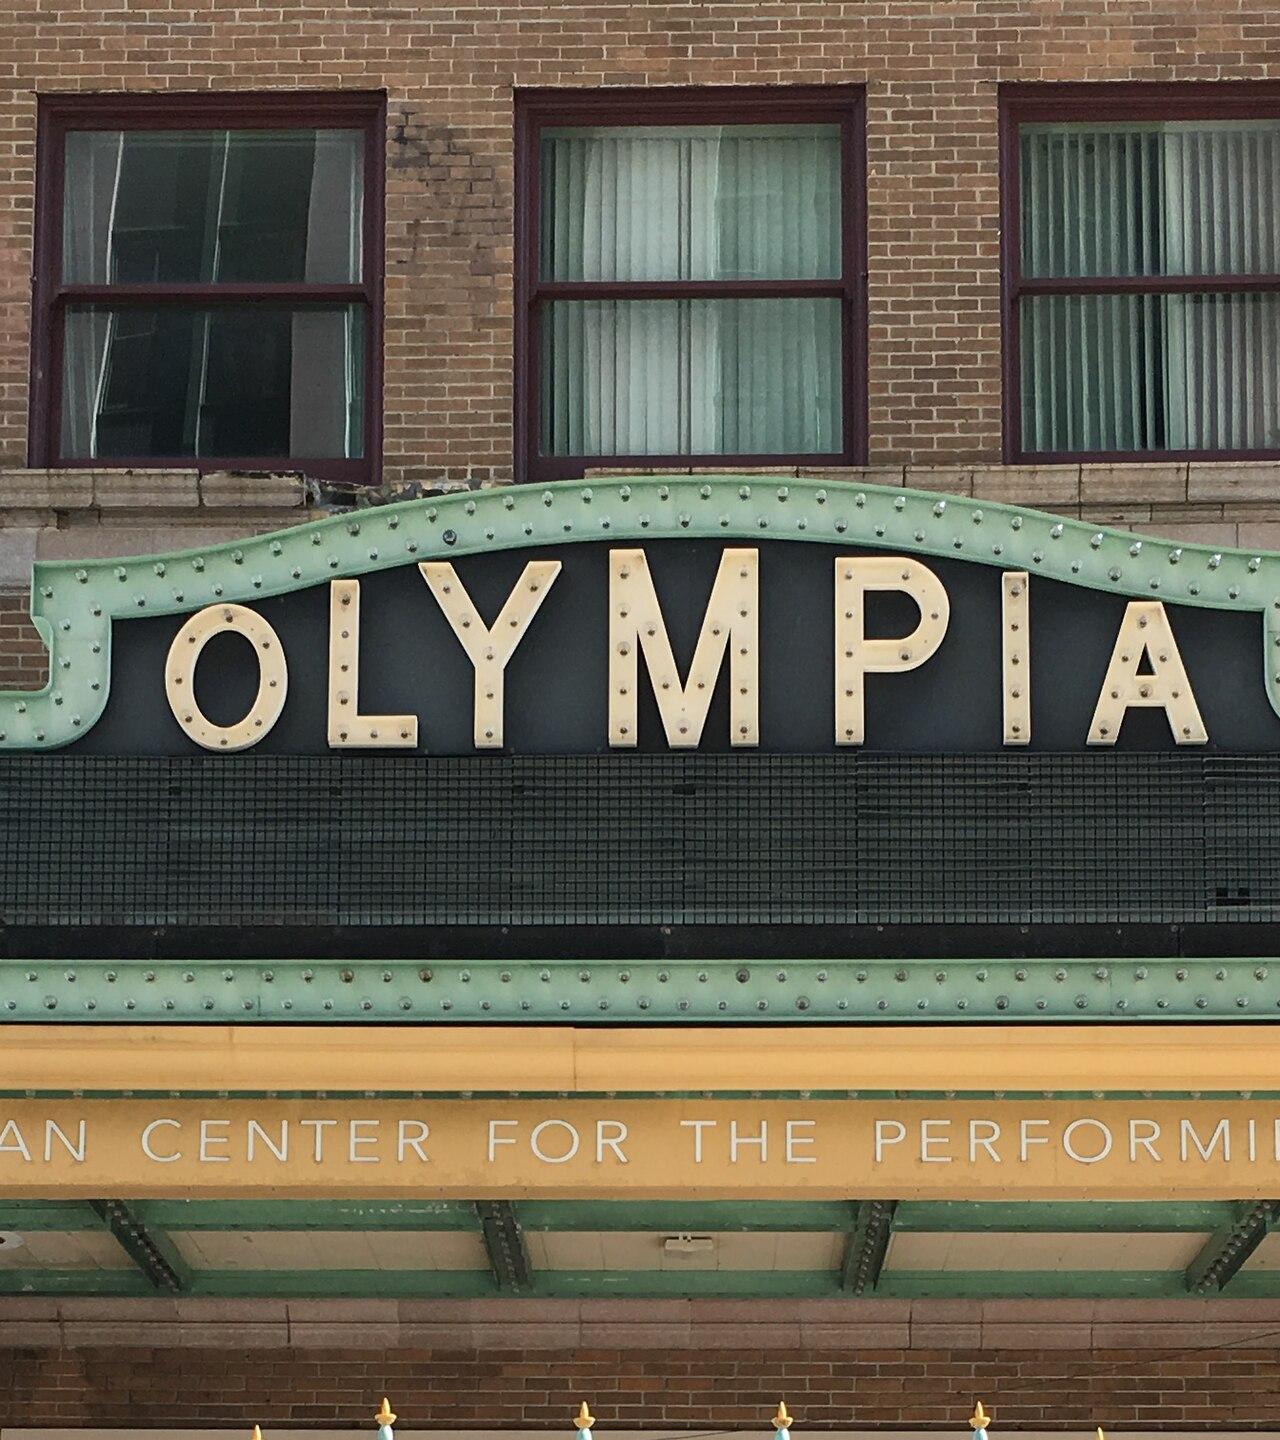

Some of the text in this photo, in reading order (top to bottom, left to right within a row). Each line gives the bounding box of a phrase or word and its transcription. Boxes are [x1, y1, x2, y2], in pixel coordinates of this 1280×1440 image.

[165, 548, 1208, 752] OLYMPIA
[141, 1118, 430, 1163] CENTER
[487, 1118, 630, 1163] FOR
[680, 1119, 817, 1163] THE
